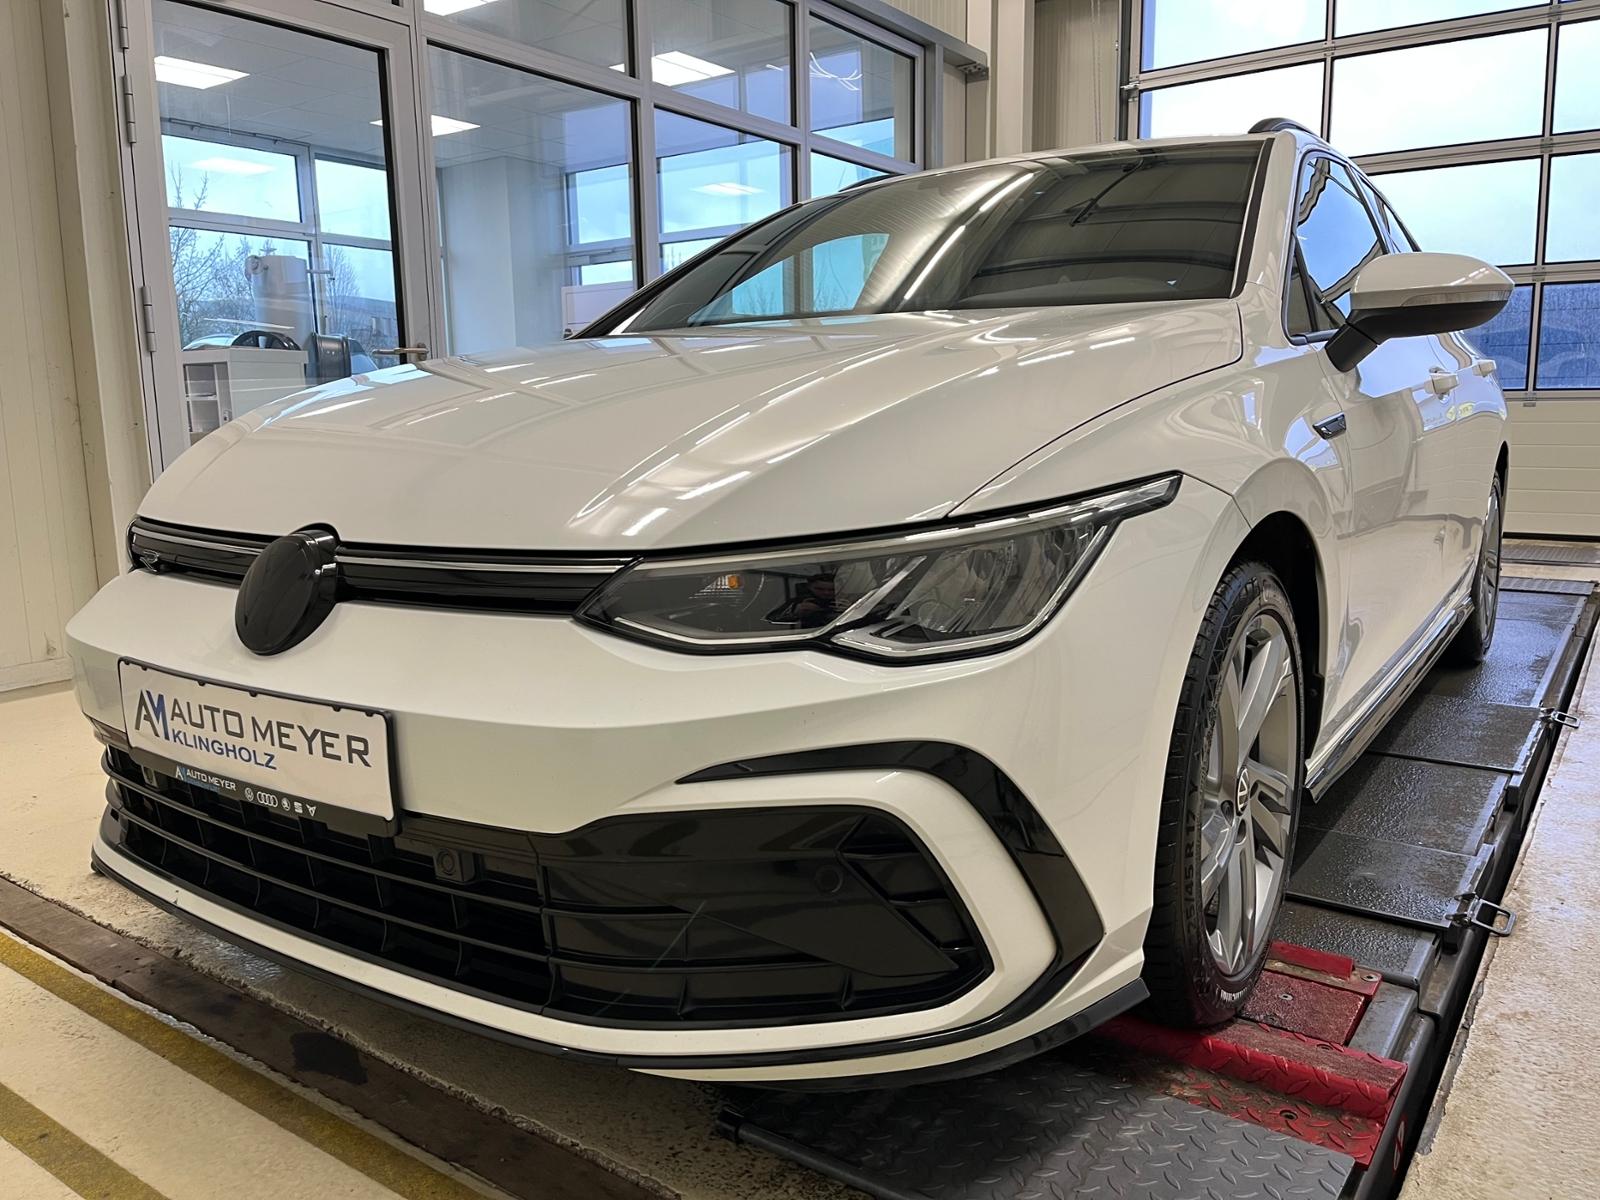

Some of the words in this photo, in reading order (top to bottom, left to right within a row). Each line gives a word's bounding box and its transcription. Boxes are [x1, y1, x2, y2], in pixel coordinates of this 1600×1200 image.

[170, 698, 245, 738] AUTO
[251, 716, 372, 767] MEYER
[171, 728, 277, 770] KLINGHOLZ
[186, 768, 207, 782] AUTO
[208, 775, 237, 791] MEYER
[1184, 865, 1197, 945] 25/45
